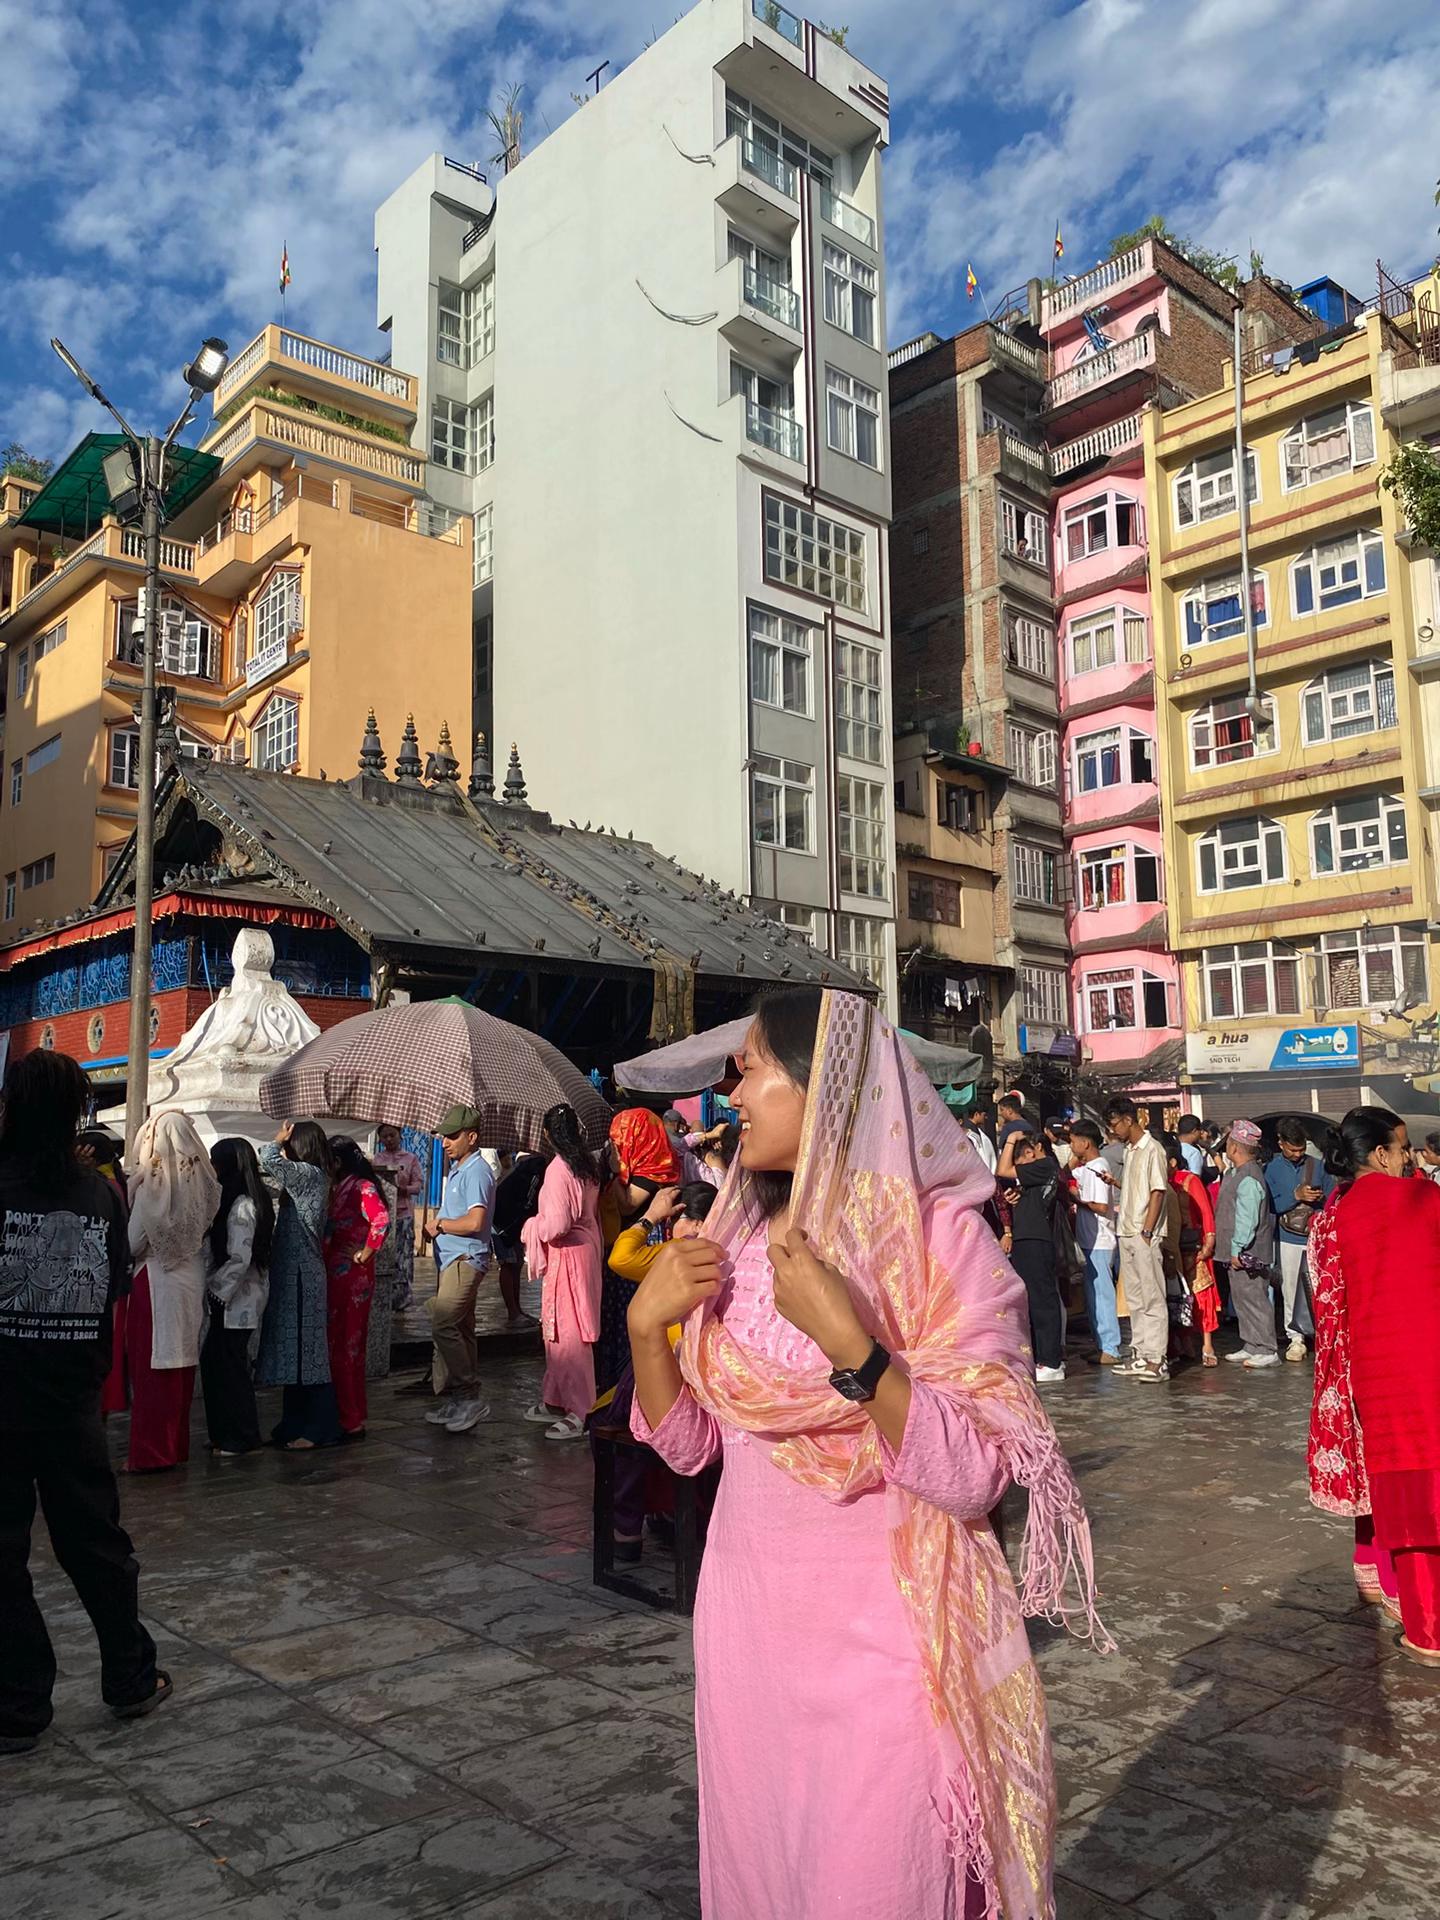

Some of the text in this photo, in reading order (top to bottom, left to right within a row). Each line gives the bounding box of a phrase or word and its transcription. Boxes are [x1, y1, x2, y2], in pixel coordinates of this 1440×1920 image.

[266, 639, 286, 659] CENTER
[5, 1209, 45, 1227] DON'T
[17, 1317, 41, 1327] SLEEP
[41, 1318, 59, 1327] LIKE
[0, 1327, 99, 1341] ORK LIKE YOU'RE BROKE
